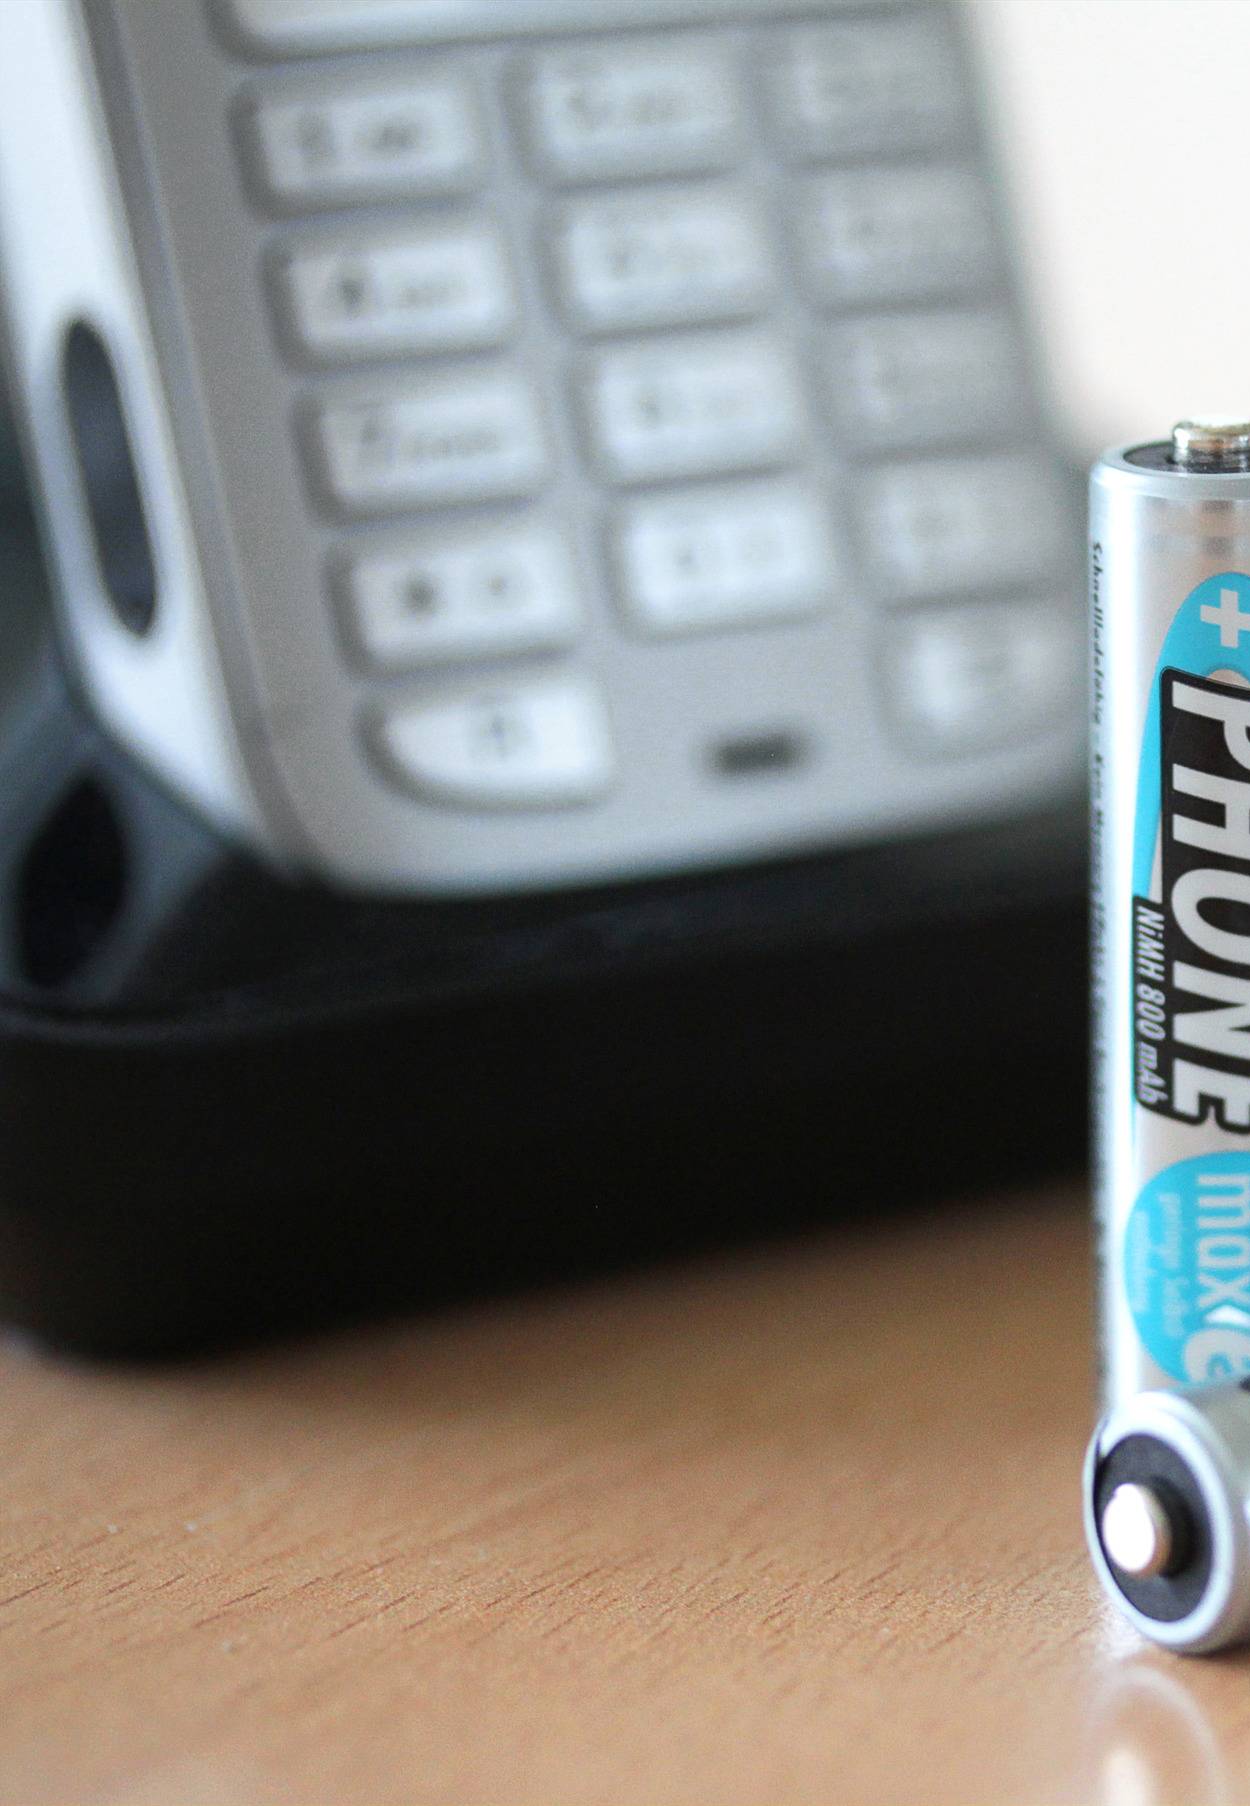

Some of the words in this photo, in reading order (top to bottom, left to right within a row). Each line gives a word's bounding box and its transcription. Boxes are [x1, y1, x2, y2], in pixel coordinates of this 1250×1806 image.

[1136, 906, 1165, 982] NiMH
[1136, 983, 1166, 1041] 800
[1138, 1041, 1168, 1104] mAh
